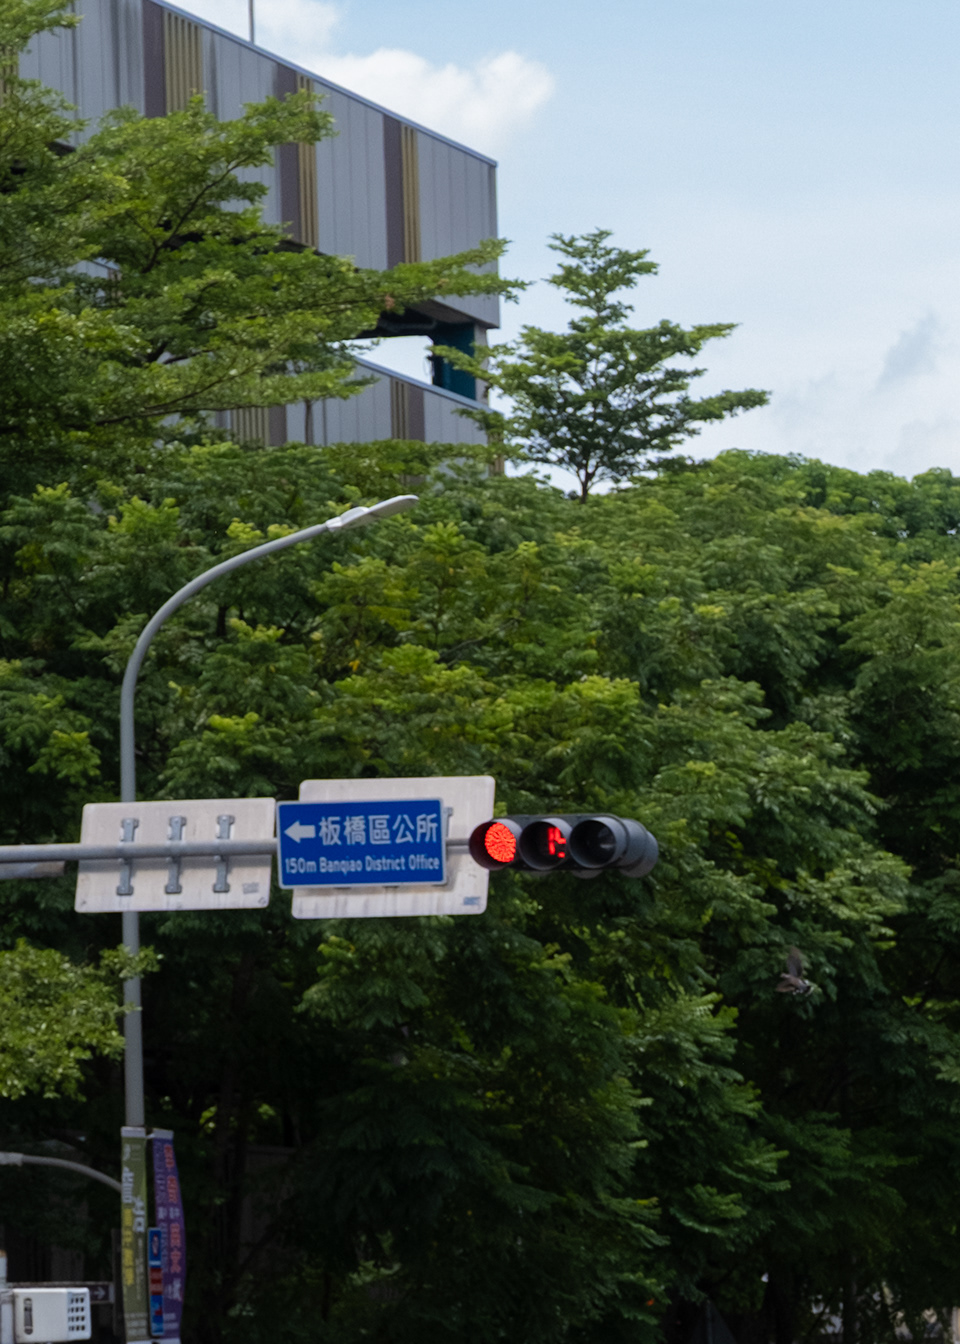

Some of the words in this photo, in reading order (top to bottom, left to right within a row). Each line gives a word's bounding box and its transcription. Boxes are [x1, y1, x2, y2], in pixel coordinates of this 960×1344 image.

[319, 813, 438, 846] 板橋區公所
[285, 857, 317, 874] 150m
[319, 855, 363, 876] Banqiao
[365, 854, 406, 872] District
[408, 855, 440, 871] Office
